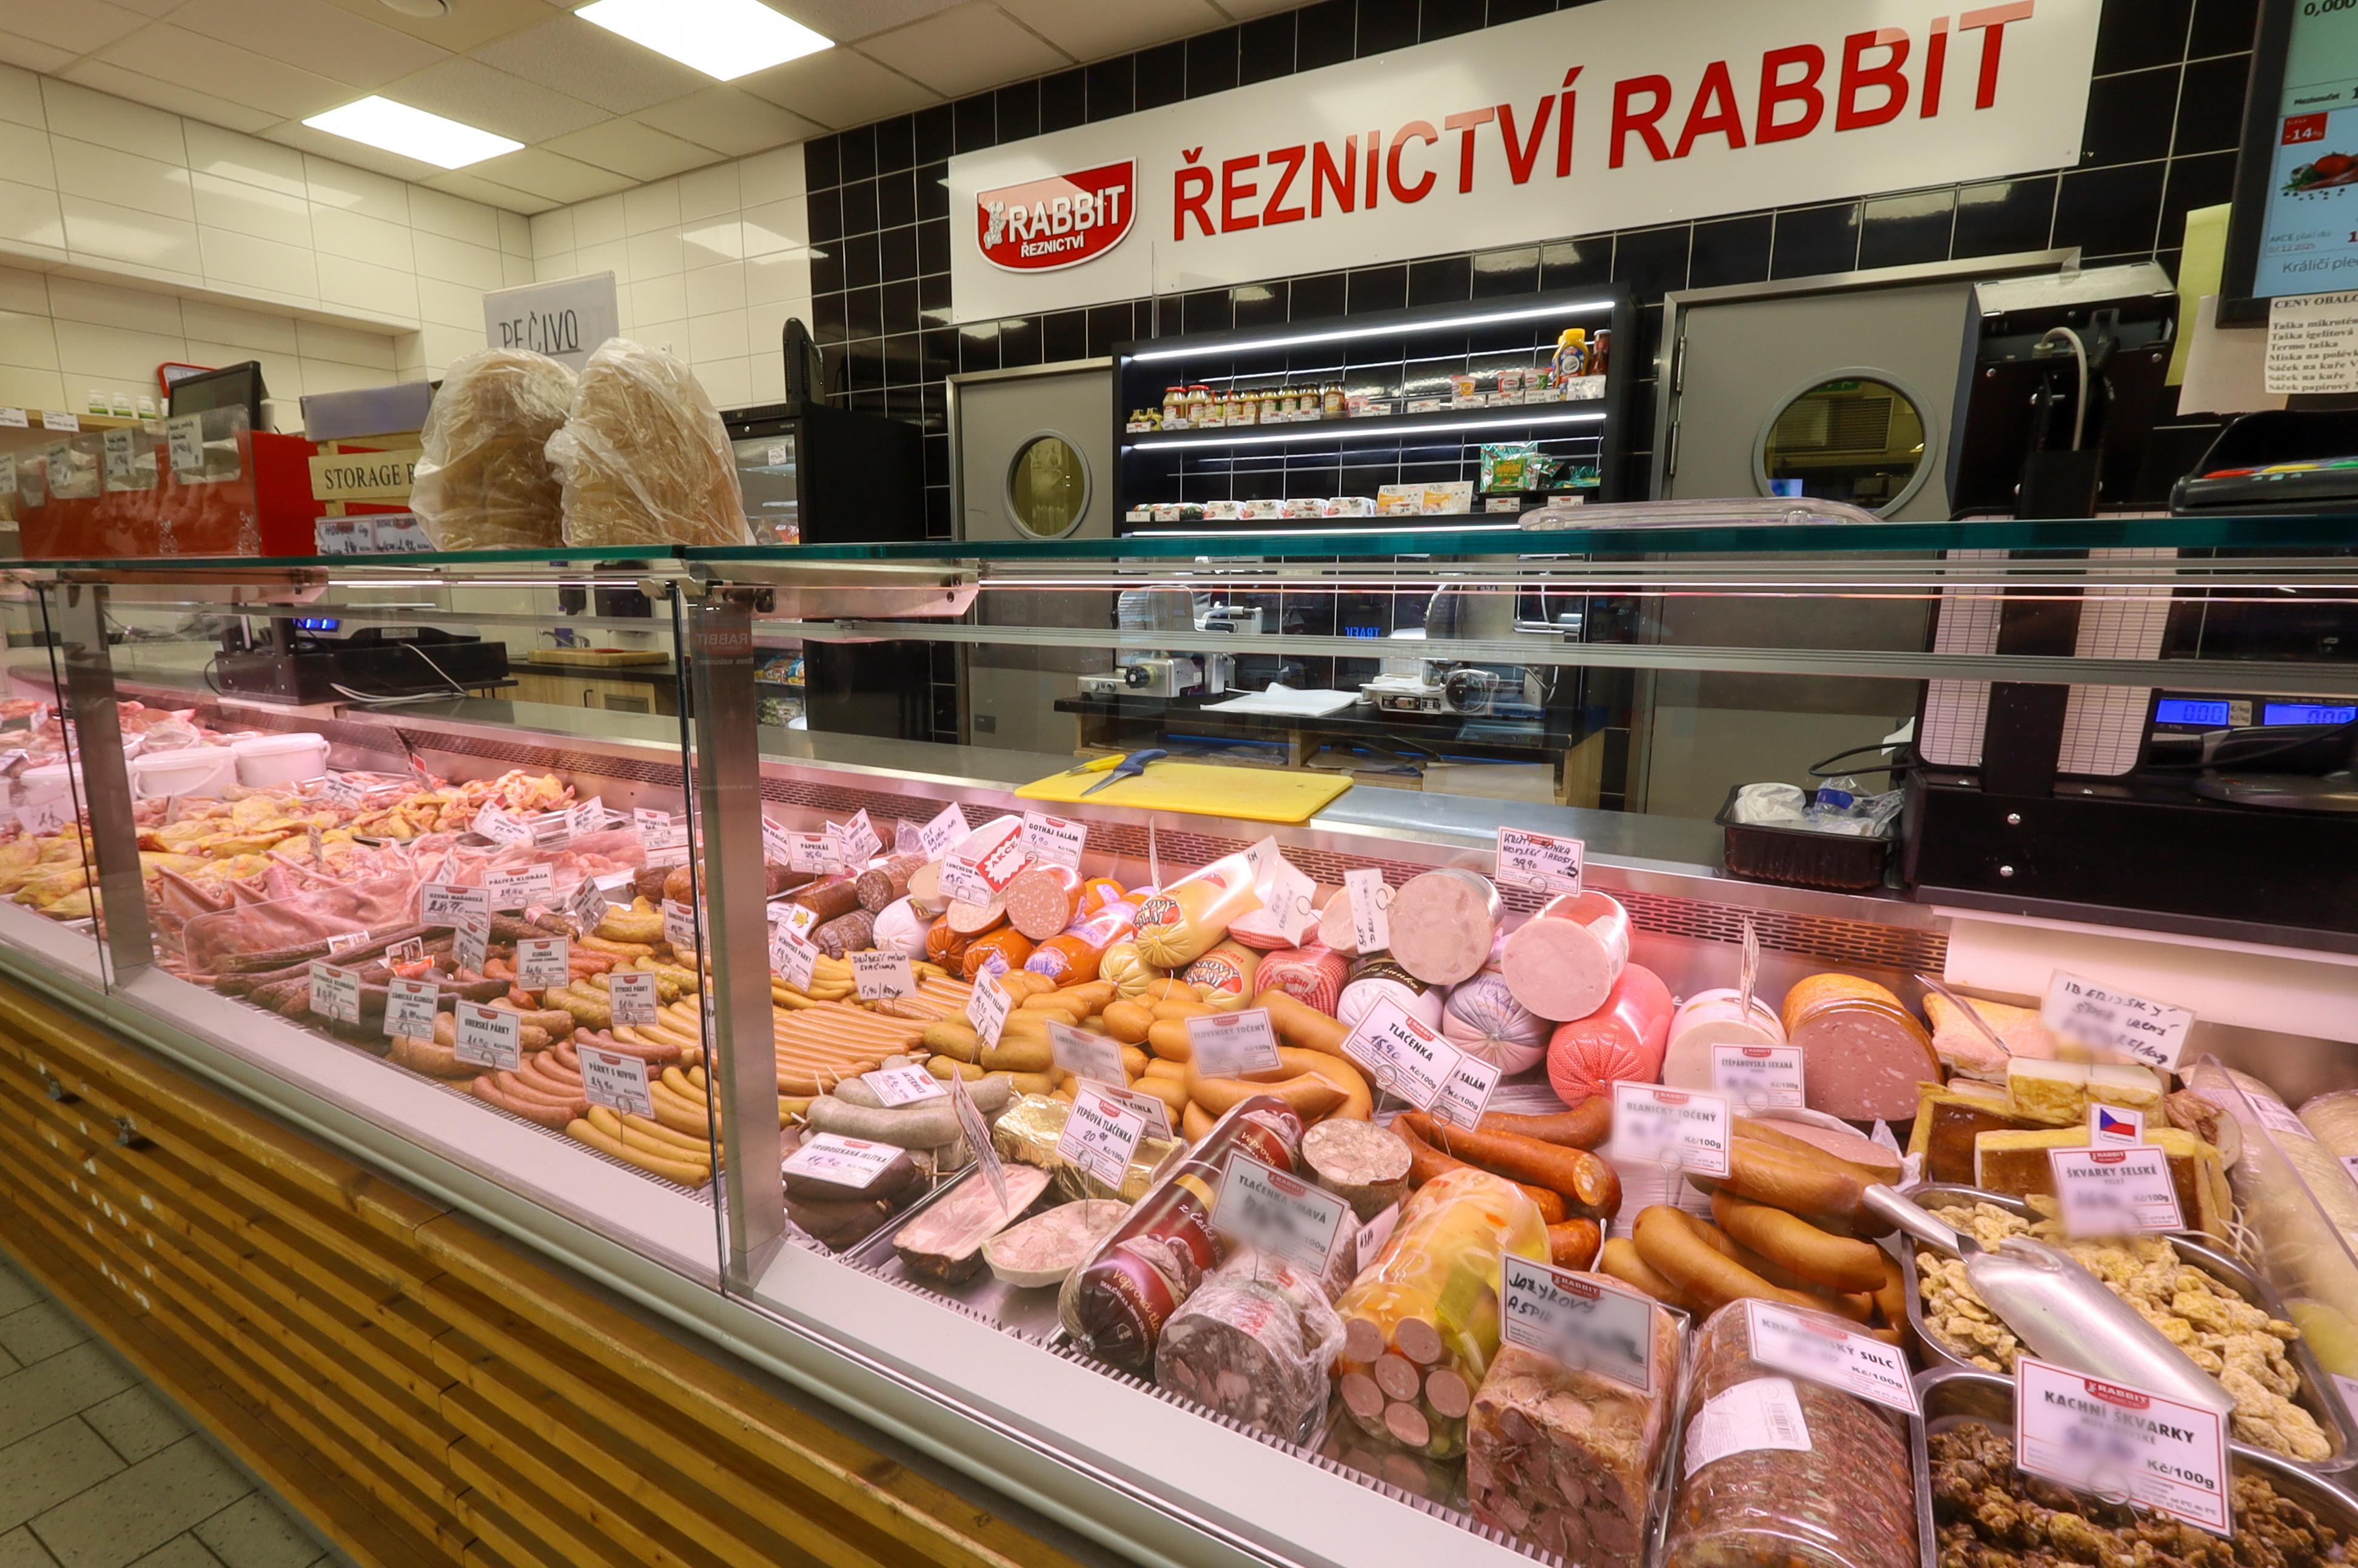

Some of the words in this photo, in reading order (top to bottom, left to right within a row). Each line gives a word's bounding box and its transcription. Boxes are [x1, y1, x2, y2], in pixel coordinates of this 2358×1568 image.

[1174, 65, 1585, 241] ŘEZNICTVÍ
[1609, 1, 2034, 169] RABBIT
[1009, 185, 1126, 242] RABBIT
[1021, 232, 1084, 258] ŘEZNICTVÍ
[2282, 258, 2330, 273] Králičí
[2274, 298, 2311, 309] CENY
[2272, 321, 2303, 330] Taška
[2306, 328, 2354, 340] igelitová
[2271, 343, 2306, 352] Termo
[2309, 341, 2339, 349] taška
[2269, 353, 2302, 361] Miska
[2319, 361, 2346, 370] kuře
[324, 463, 401, 490] STORAGE
[1029, 823, 1055, 836] GOTHAJ
[1056, 828, 1078, 843] SALÁM
[991, 840, 1018, 868] AKCE
[490, 1022, 510, 1035] PÁRKY
[1388, 1022, 1434, 1062] TLAČENKA
[588, 1062, 610, 1075] PÁRKY
[616, 1070, 638, 1082] NIVOU
[1409, 1064, 1437, 1090] Kč/100g
[1460, 1072, 1486, 1093] SALÁM
[1129, 1102, 1153, 1114] CIHLA
[1678, 1108, 1716, 1122] TOČENÝ
[1076, 1105, 1103, 1127] VEPŘOVÁ
[1101, 1119, 1132, 1144] TLAČENKA
[1684, 1135, 1722, 1149] Kč/100g
[860, 1150, 888, 1164] JELÍTKA
[2066, 1166, 2117, 1178] ŠKVARKY
[2120, 1163, 2158, 1176] SELSKÉ
[1238, 1174, 1288, 1207] TLAČENKA
[1561, 1278, 1599, 1295] RABBIT
[1860, 1350, 1895, 1370] SULC
[2097, 1385, 2150, 1405] RABBIT
[2044, 1389, 2108, 1419] KACHNÍ
[2114, 1407, 2195, 1444] ŠKVARKY
[2146, 1458, 2215, 1490] Kč/100g
